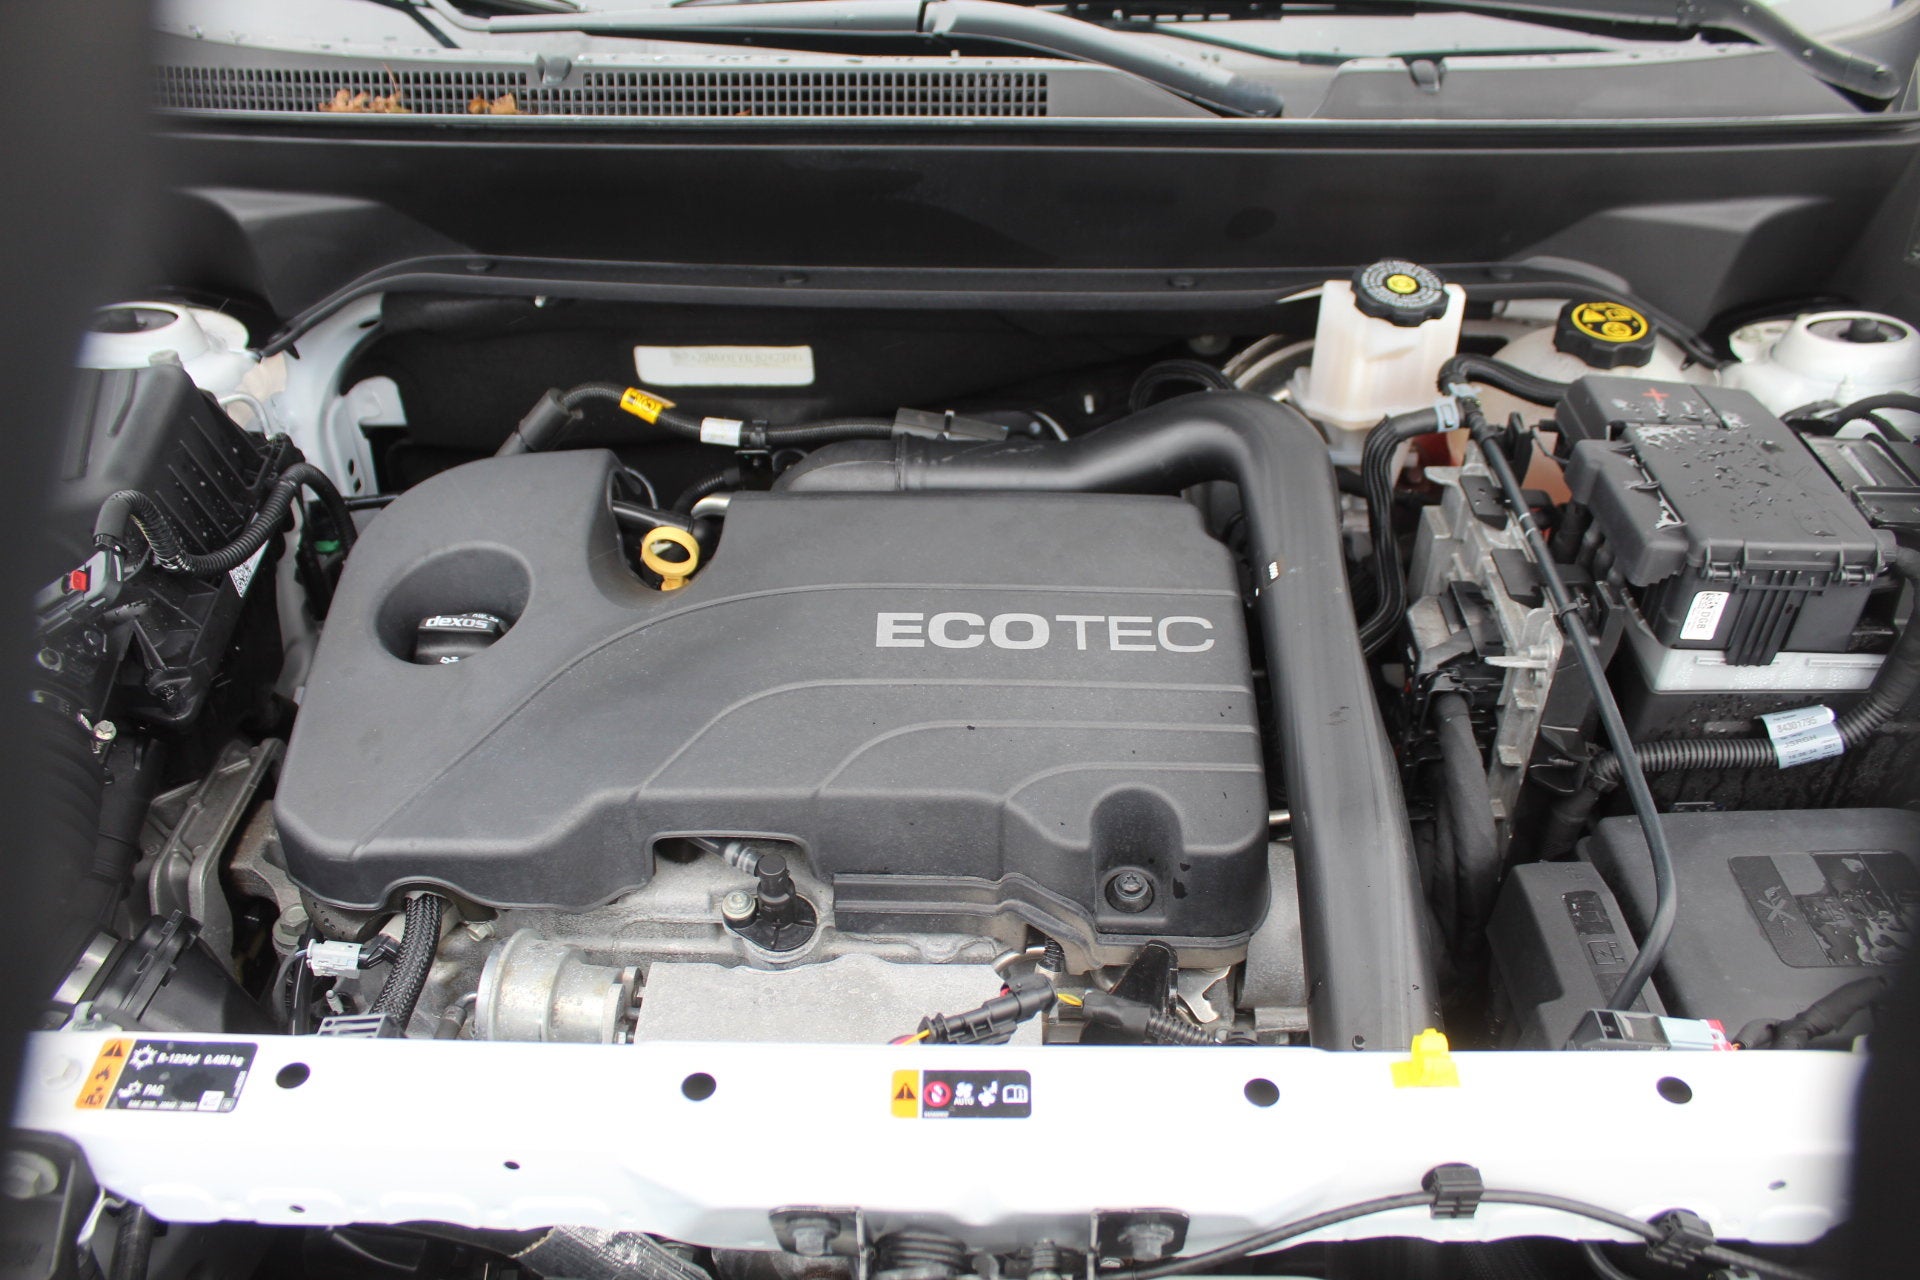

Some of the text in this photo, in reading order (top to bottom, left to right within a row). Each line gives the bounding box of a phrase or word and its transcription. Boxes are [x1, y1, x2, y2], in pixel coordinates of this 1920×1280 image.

[425, 616, 489, 629] dexos
[875, 612, 1215, 653] ECOTEC
[953, 1096, 975, 1106] AUTO
